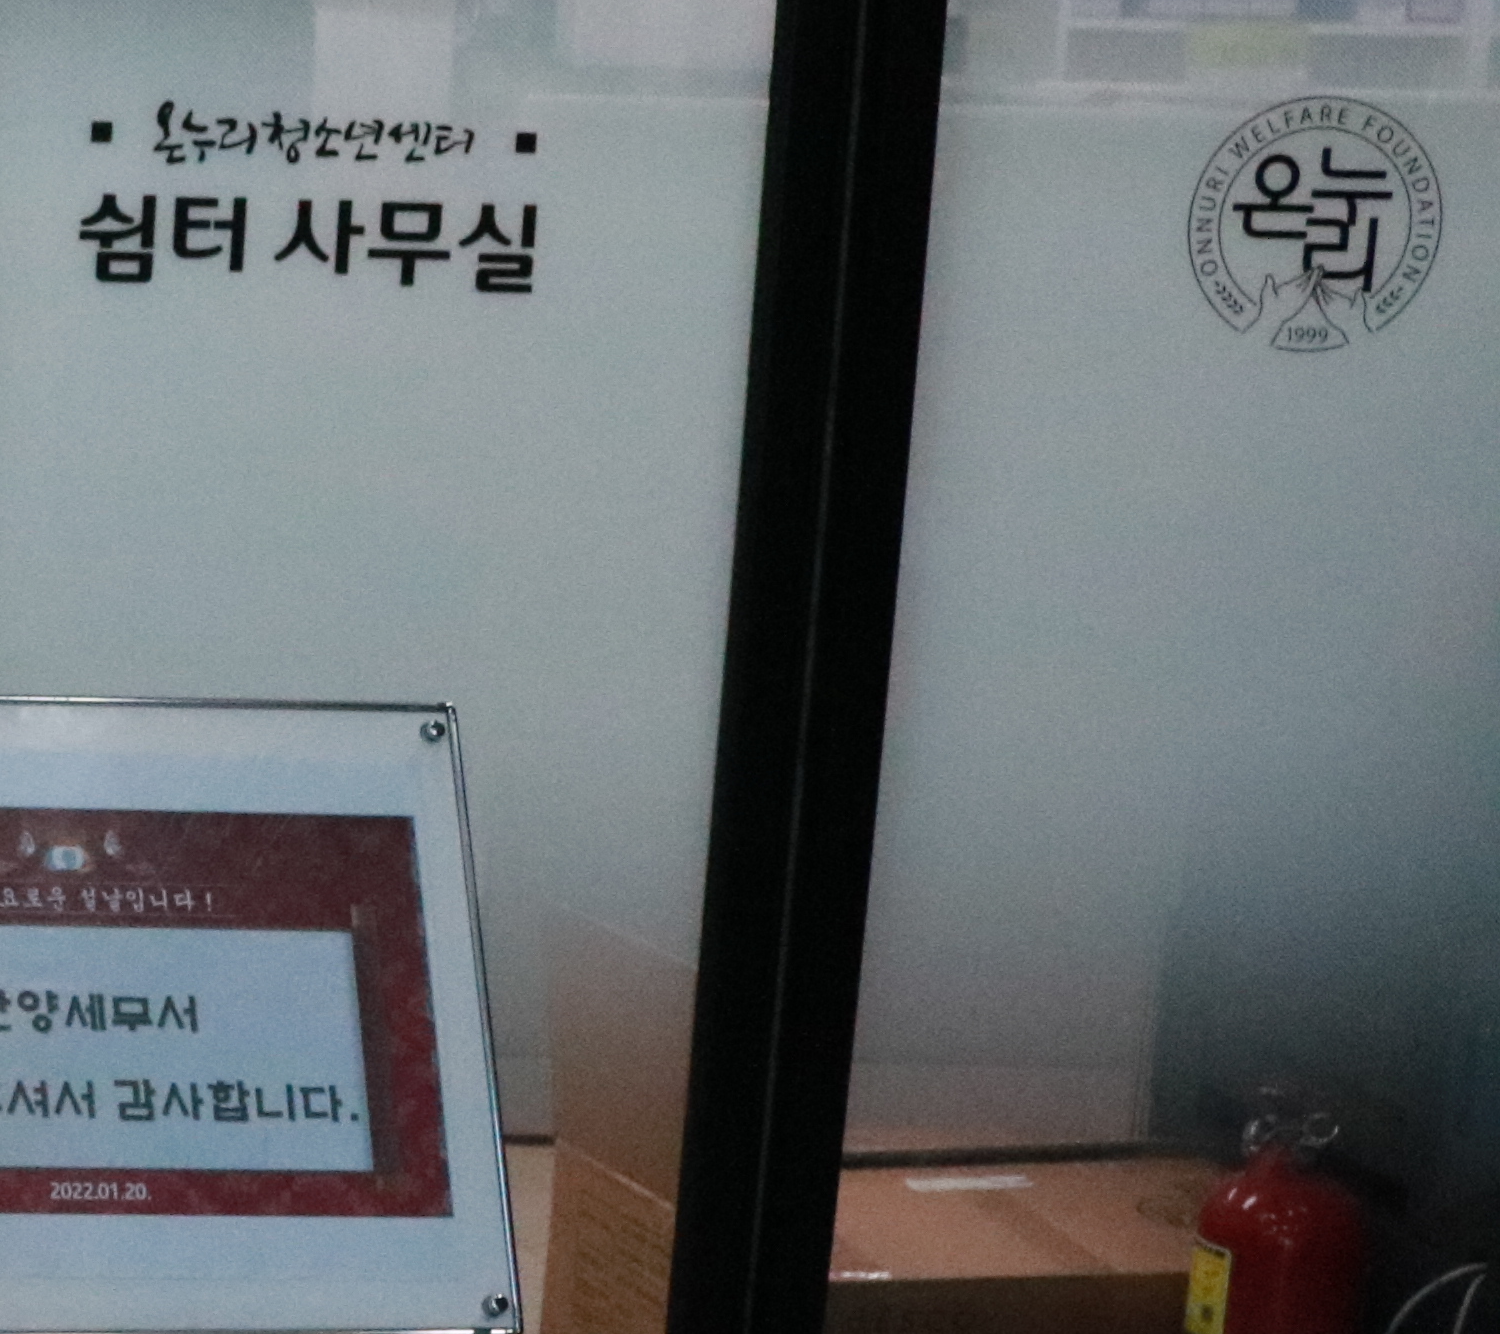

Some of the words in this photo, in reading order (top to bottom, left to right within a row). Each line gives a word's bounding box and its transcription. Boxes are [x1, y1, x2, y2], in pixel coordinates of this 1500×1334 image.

[152, 100, 476, 164] 온누리청소년센터
[1196, 166, 1231, 275] ONNURI
[1228, 105, 1349, 161] WELFARE
[1361, 115, 1436, 284] FOUNDATION
[79, 194, 249, 284] 쉼터
[274, 199, 539, 294] 사무실
[1286, 325, 1329, 345] 1999
[113, 1077, 362, 1125] 감사합니다.
[49, 1180, 153, 1204] 2022.01.20.
